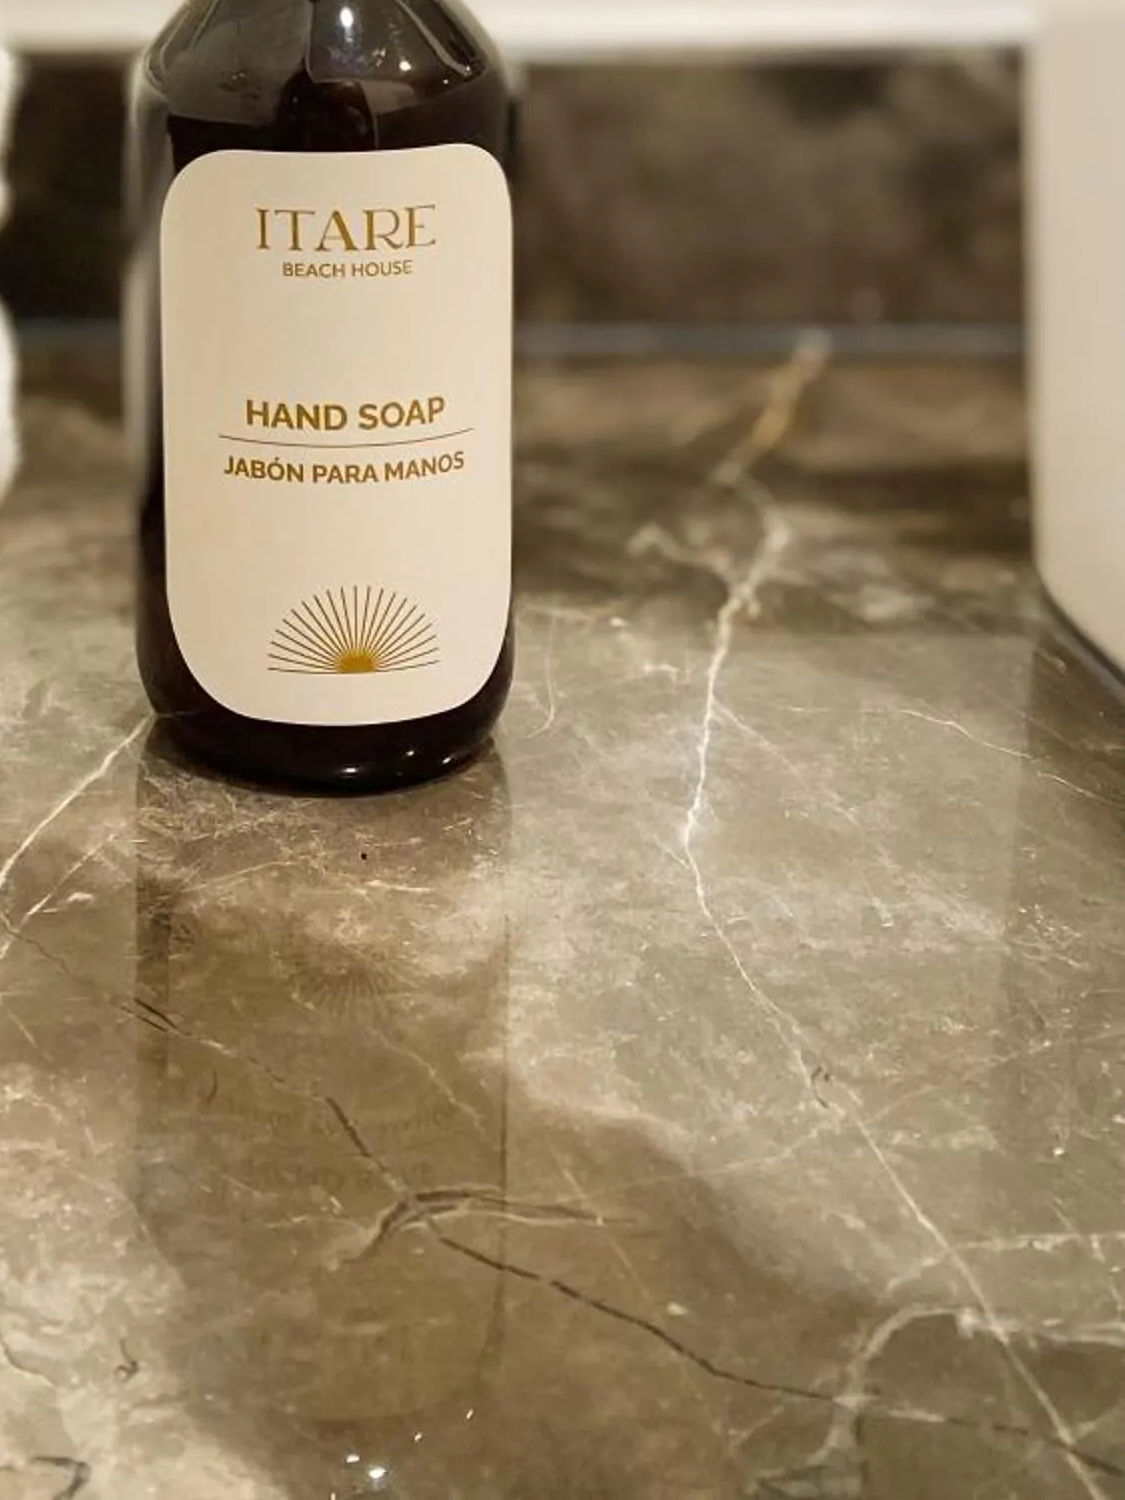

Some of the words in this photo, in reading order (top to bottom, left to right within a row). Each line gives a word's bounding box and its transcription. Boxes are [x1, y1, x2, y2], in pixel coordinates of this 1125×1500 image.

[256, 204, 437, 251] ITARE
[282, 261, 345, 278] BEACH
[352, 260, 413, 277] HOUSE
[246, 399, 348, 431] HAND
[358, 397, 446, 430] SOAP
[224, 455, 305, 483] JABÓN
[312, 464, 378, 484] PARA
[384, 451, 465, 481] MANOS
